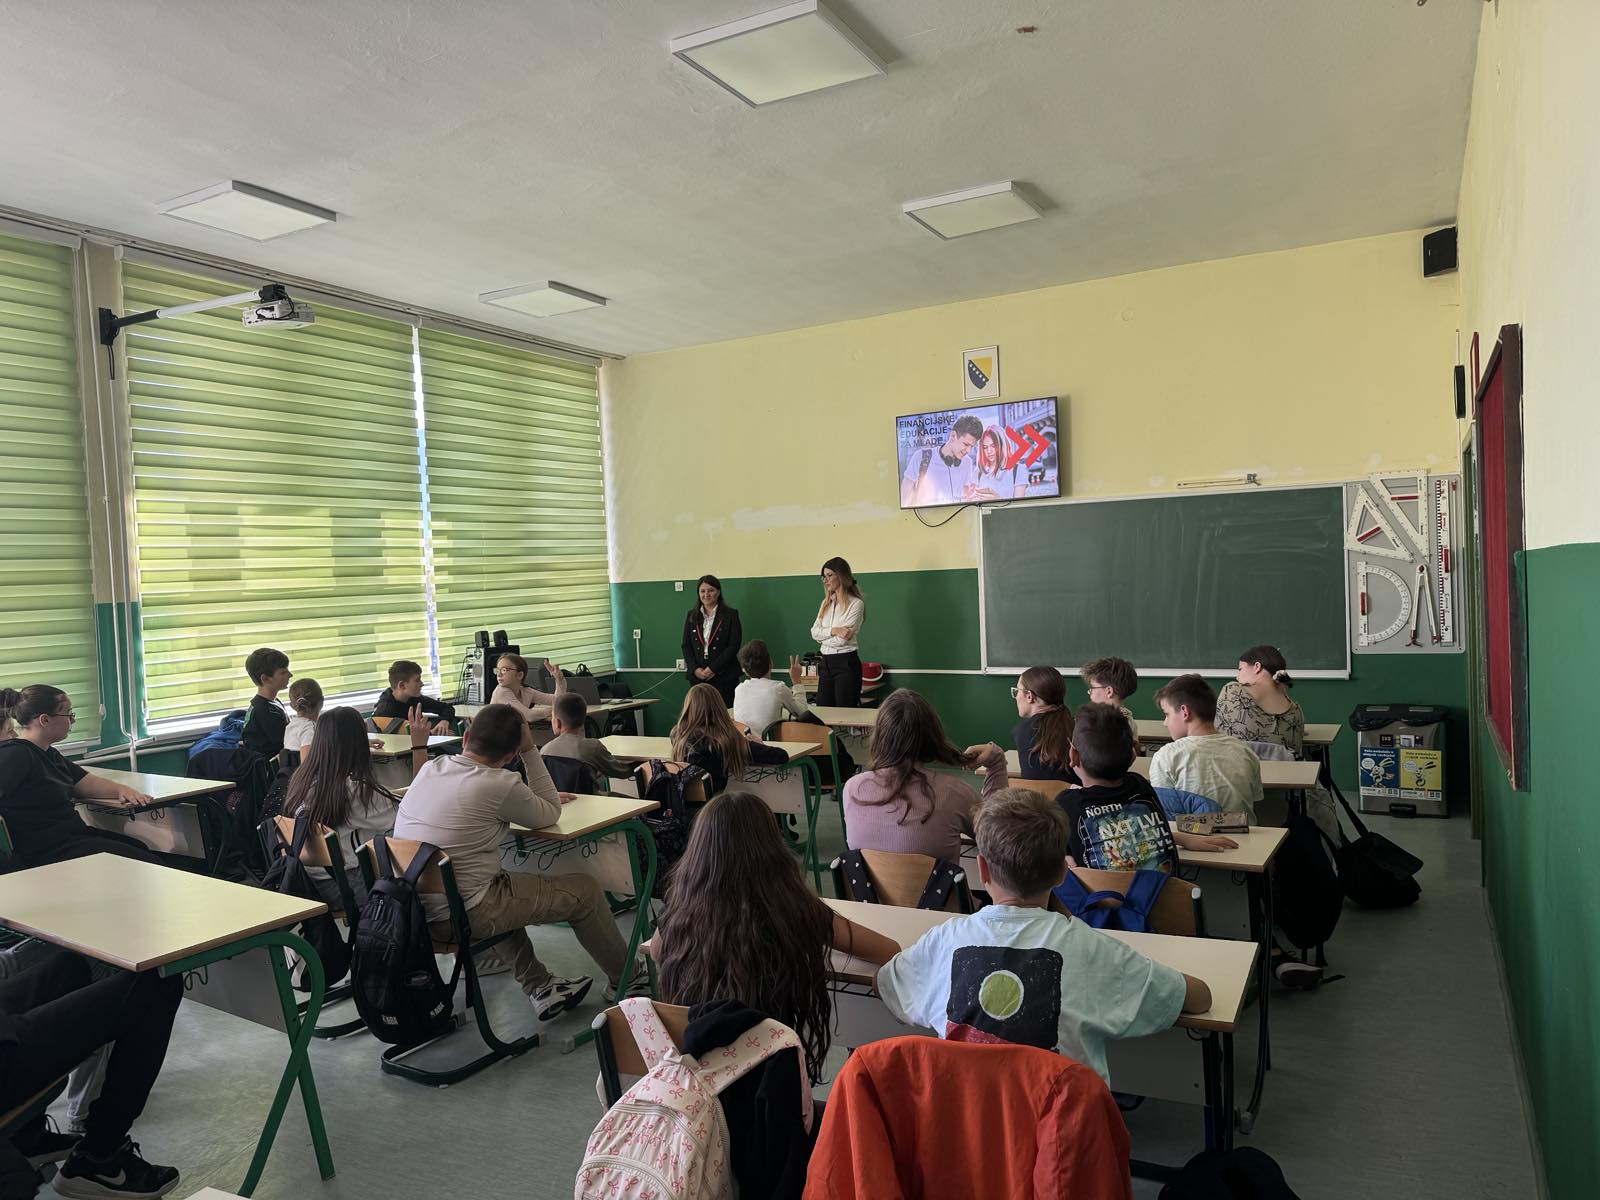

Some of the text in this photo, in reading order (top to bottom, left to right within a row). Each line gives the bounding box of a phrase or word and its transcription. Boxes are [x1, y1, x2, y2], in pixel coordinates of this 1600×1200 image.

[899, 415, 955, 428] FINANCIJSKE
[900, 426, 948, 438] EDUKACIJE
[913, 437, 943, 448] MLADE
[1085, 803, 1123, 818] NORTH
[1136, 811, 1164, 829] LVL
